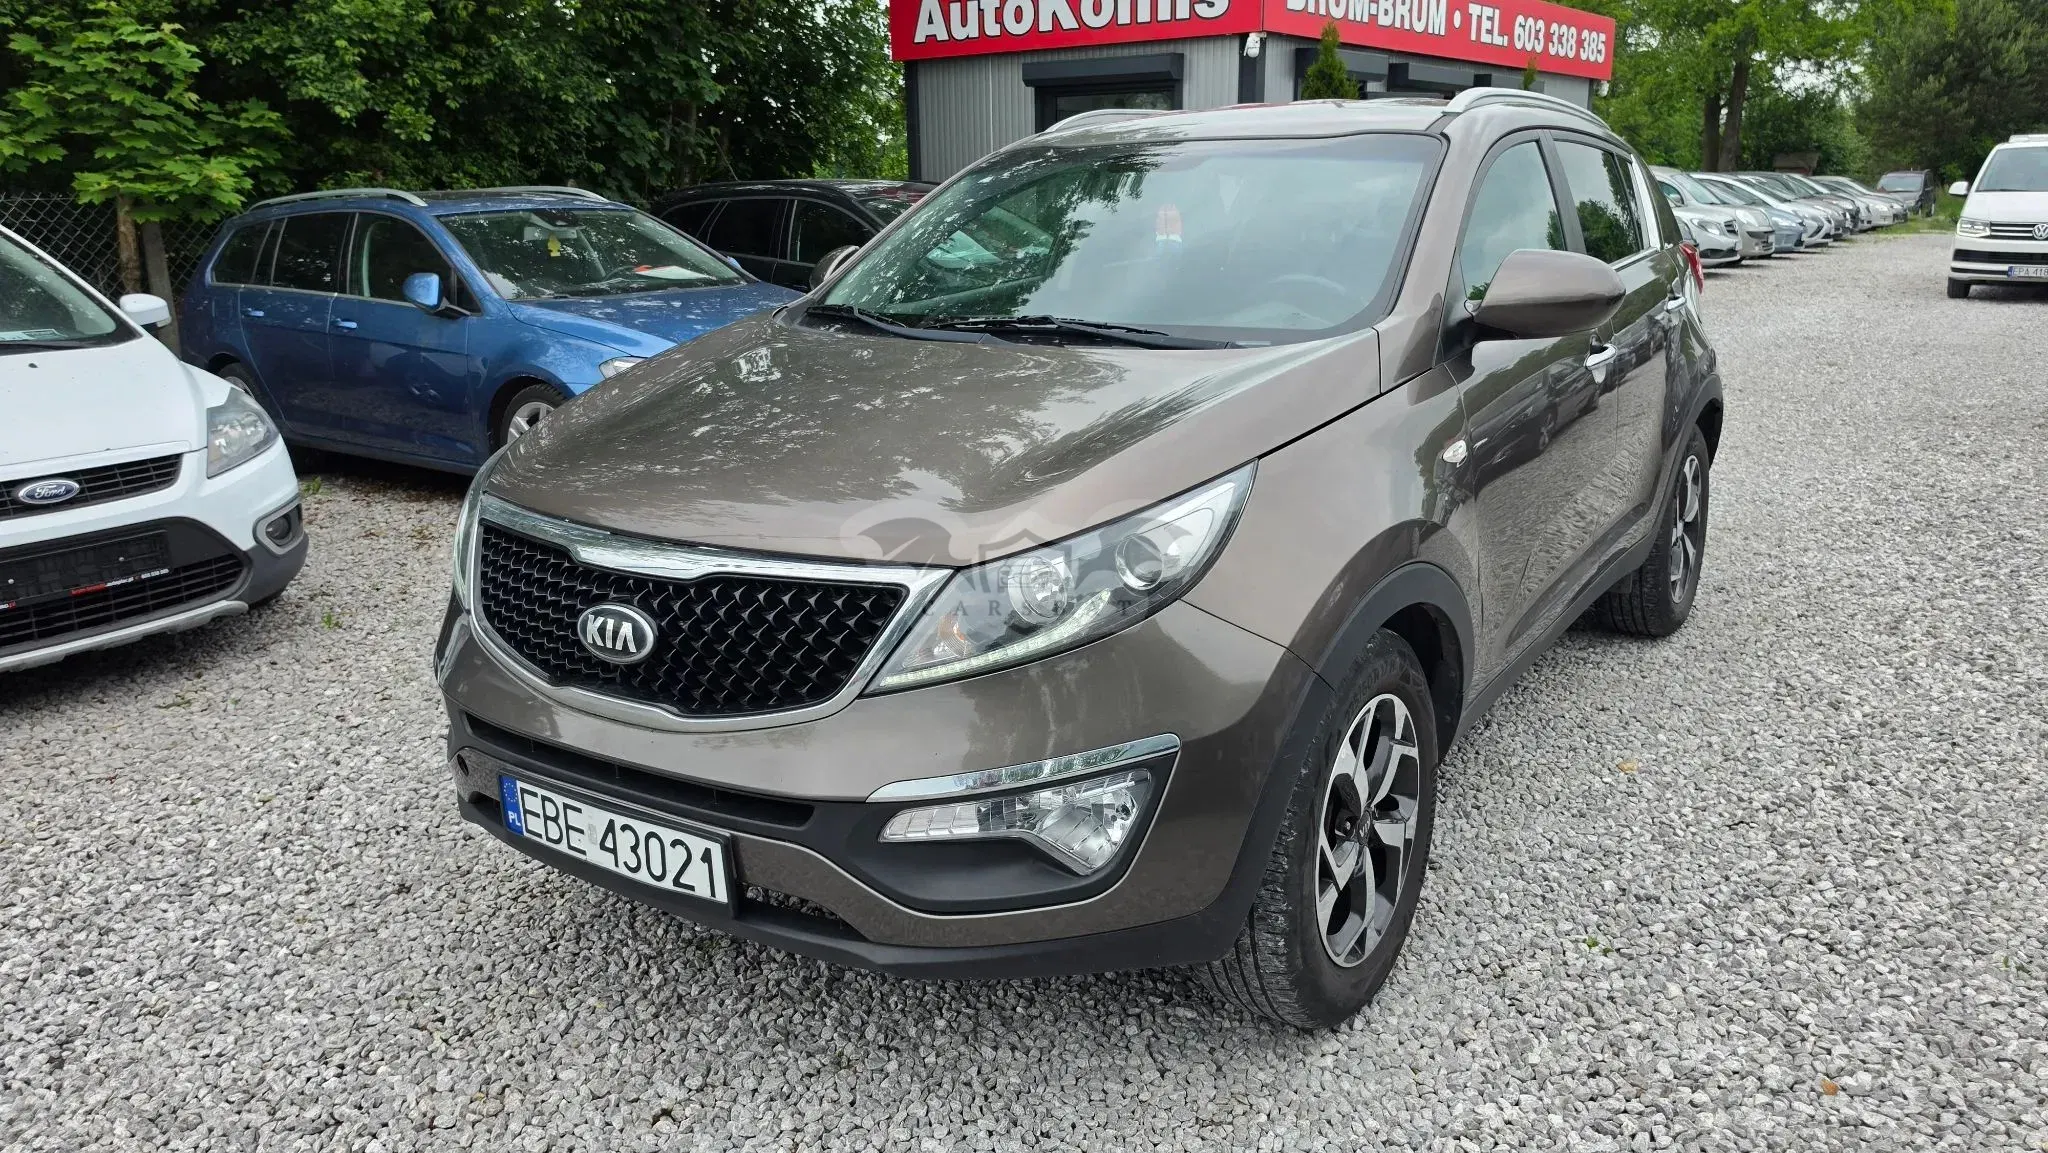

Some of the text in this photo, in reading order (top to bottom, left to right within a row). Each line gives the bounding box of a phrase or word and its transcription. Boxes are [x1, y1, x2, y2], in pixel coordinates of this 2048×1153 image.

[1286, 0, 1606, 63] M-BRUM TEL. 603 338 385
[586, 614, 637, 653] KIA
[508, 811, 522, 827] PL
[520, 786, 716, 898] EBE 43021
